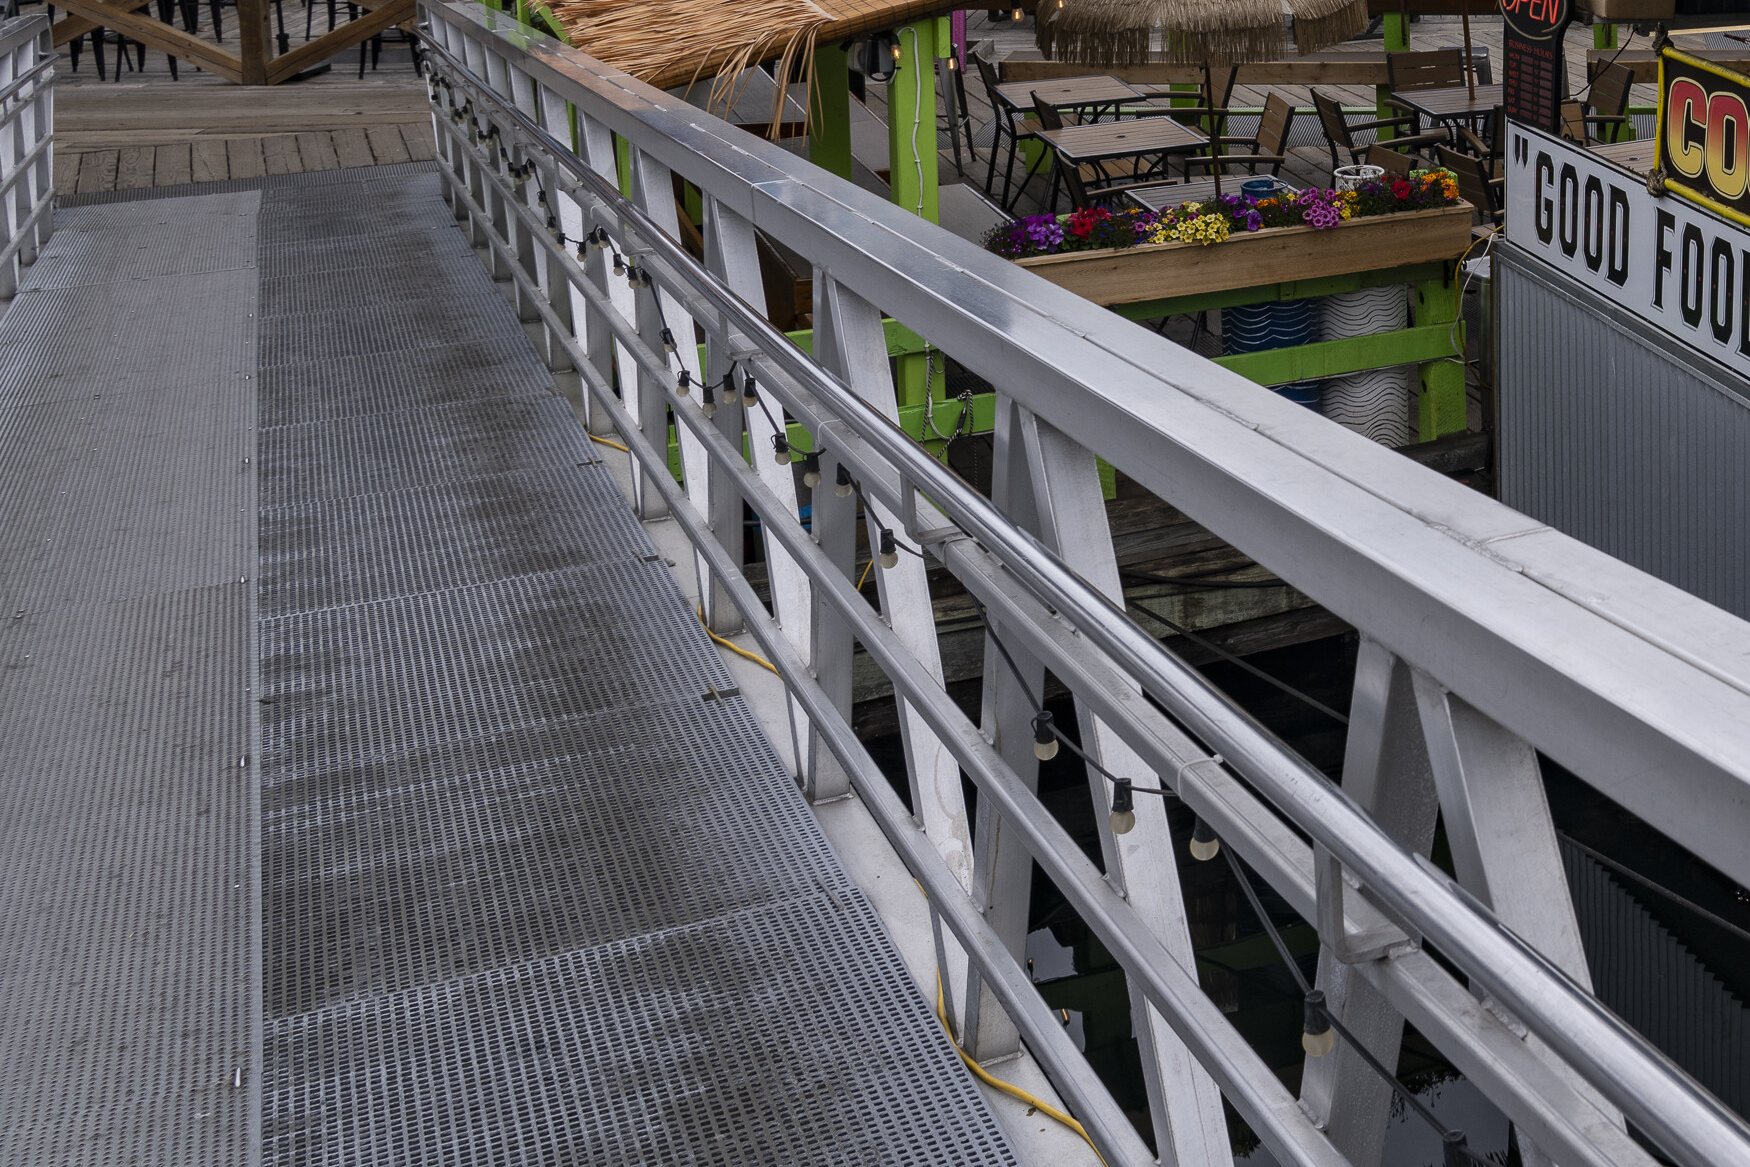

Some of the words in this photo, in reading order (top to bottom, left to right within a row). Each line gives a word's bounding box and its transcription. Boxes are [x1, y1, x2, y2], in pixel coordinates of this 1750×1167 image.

[1508, 39, 1533, 54] BUSINESS
[1533, 47, 1553, 60] HOURS
[1514, 133, 1630, 289] "GOOD
